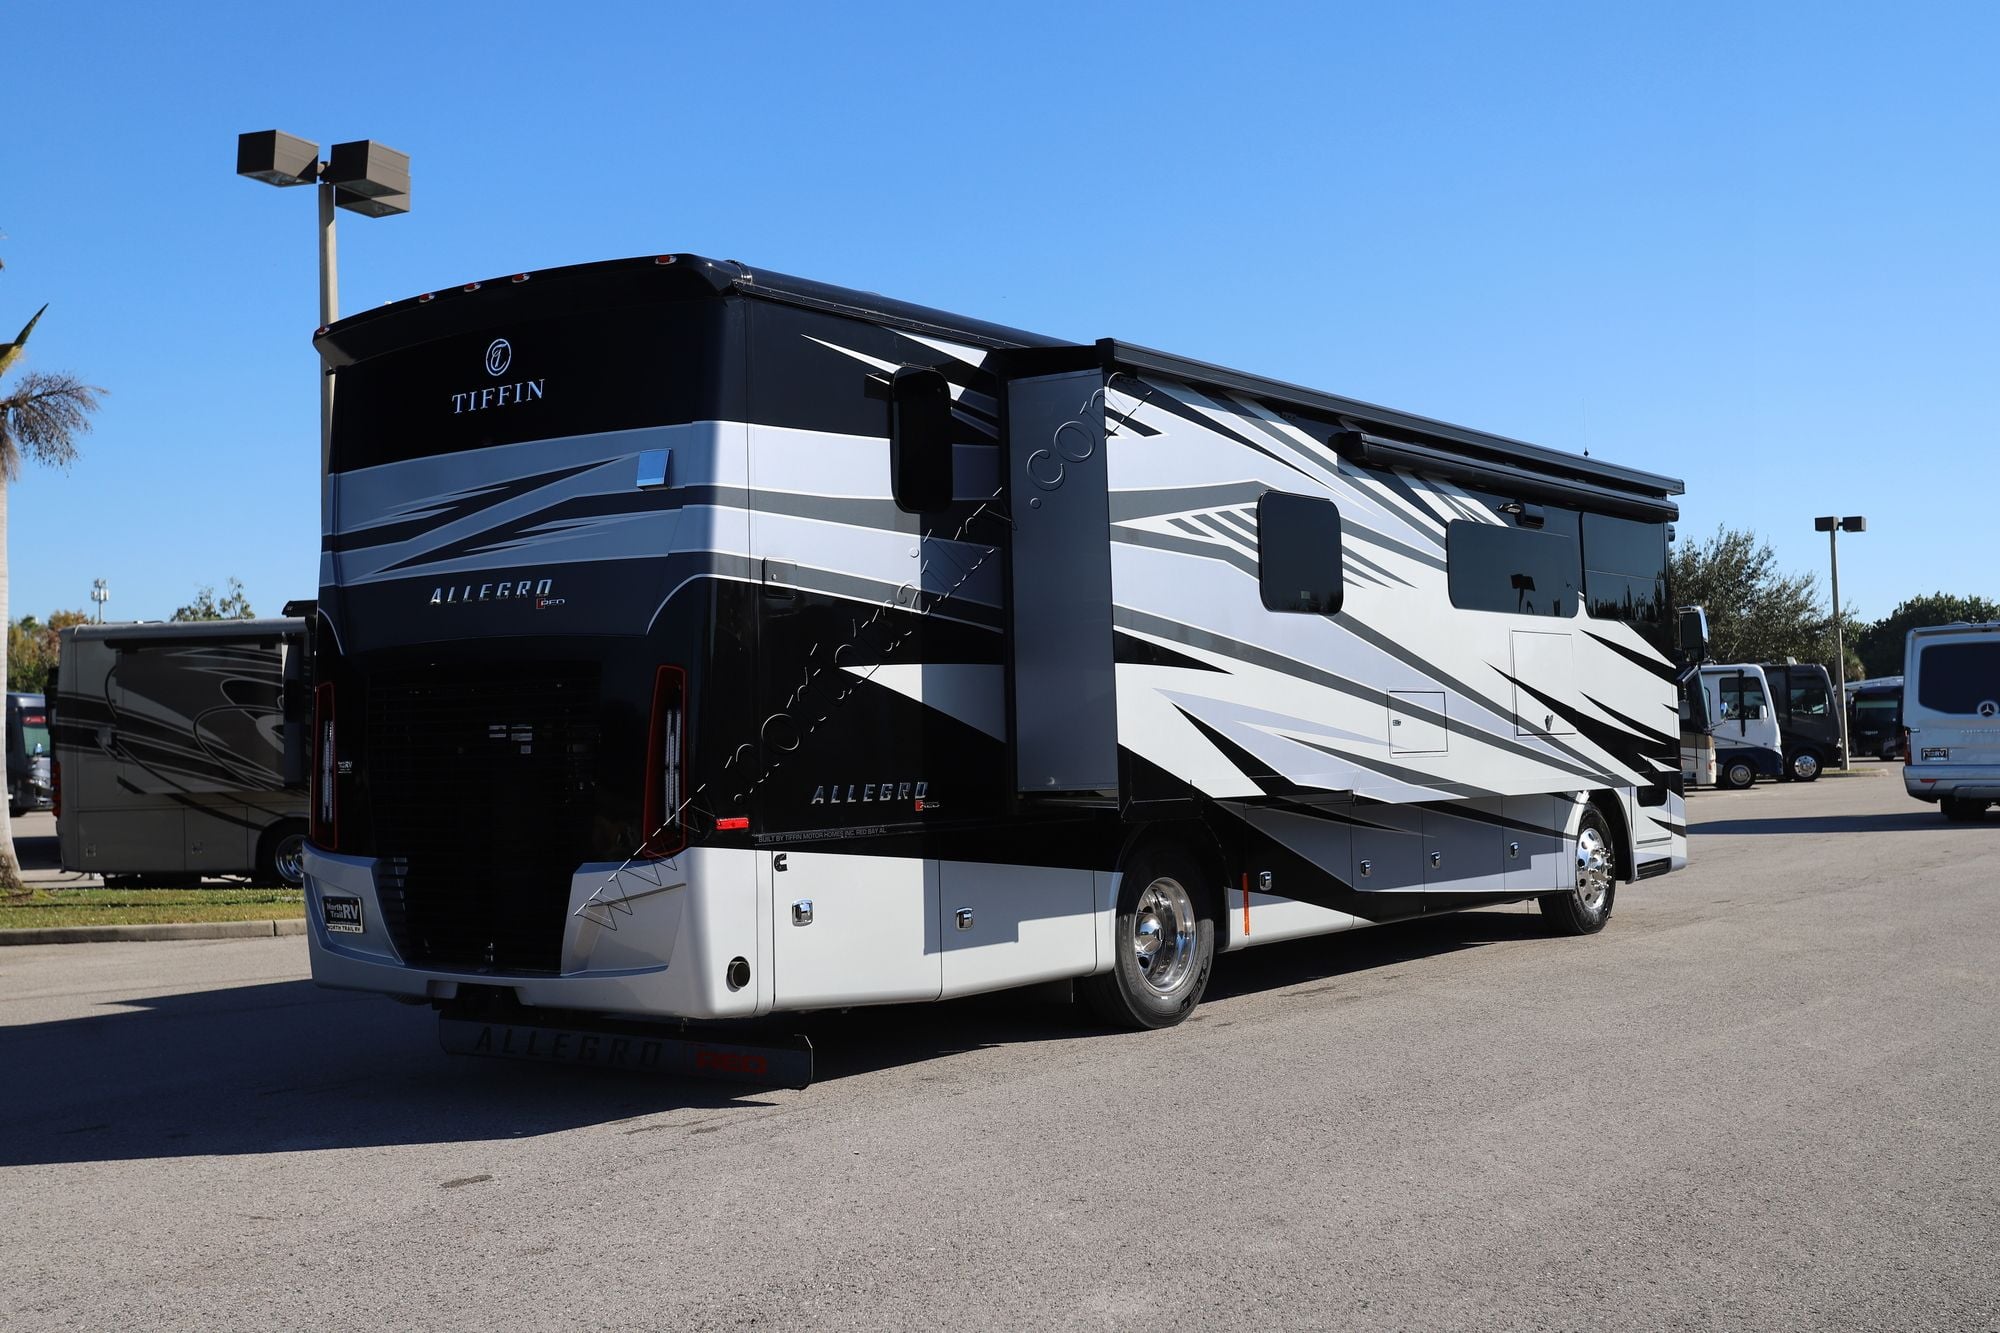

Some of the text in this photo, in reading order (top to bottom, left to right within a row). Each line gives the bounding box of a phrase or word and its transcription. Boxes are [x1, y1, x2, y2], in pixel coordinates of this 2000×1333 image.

[451, 378, 545, 414] TIFFIN
[430, 579, 552, 605] ALLEGRO
[810, 781, 929, 805] ALLEGRO
[758, 835, 775, 843] BUILT
[775, 834, 784, 842] BY
[785, 833, 802, 841] TIFFIN
[803, 832, 823, 840] MOTOR
[824, 831, 843, 839] HOMES
[342, 904, 358, 919] RV
[473, 1025, 663, 1066] ALLEGRO
[695, 1050, 769, 1075] RED
